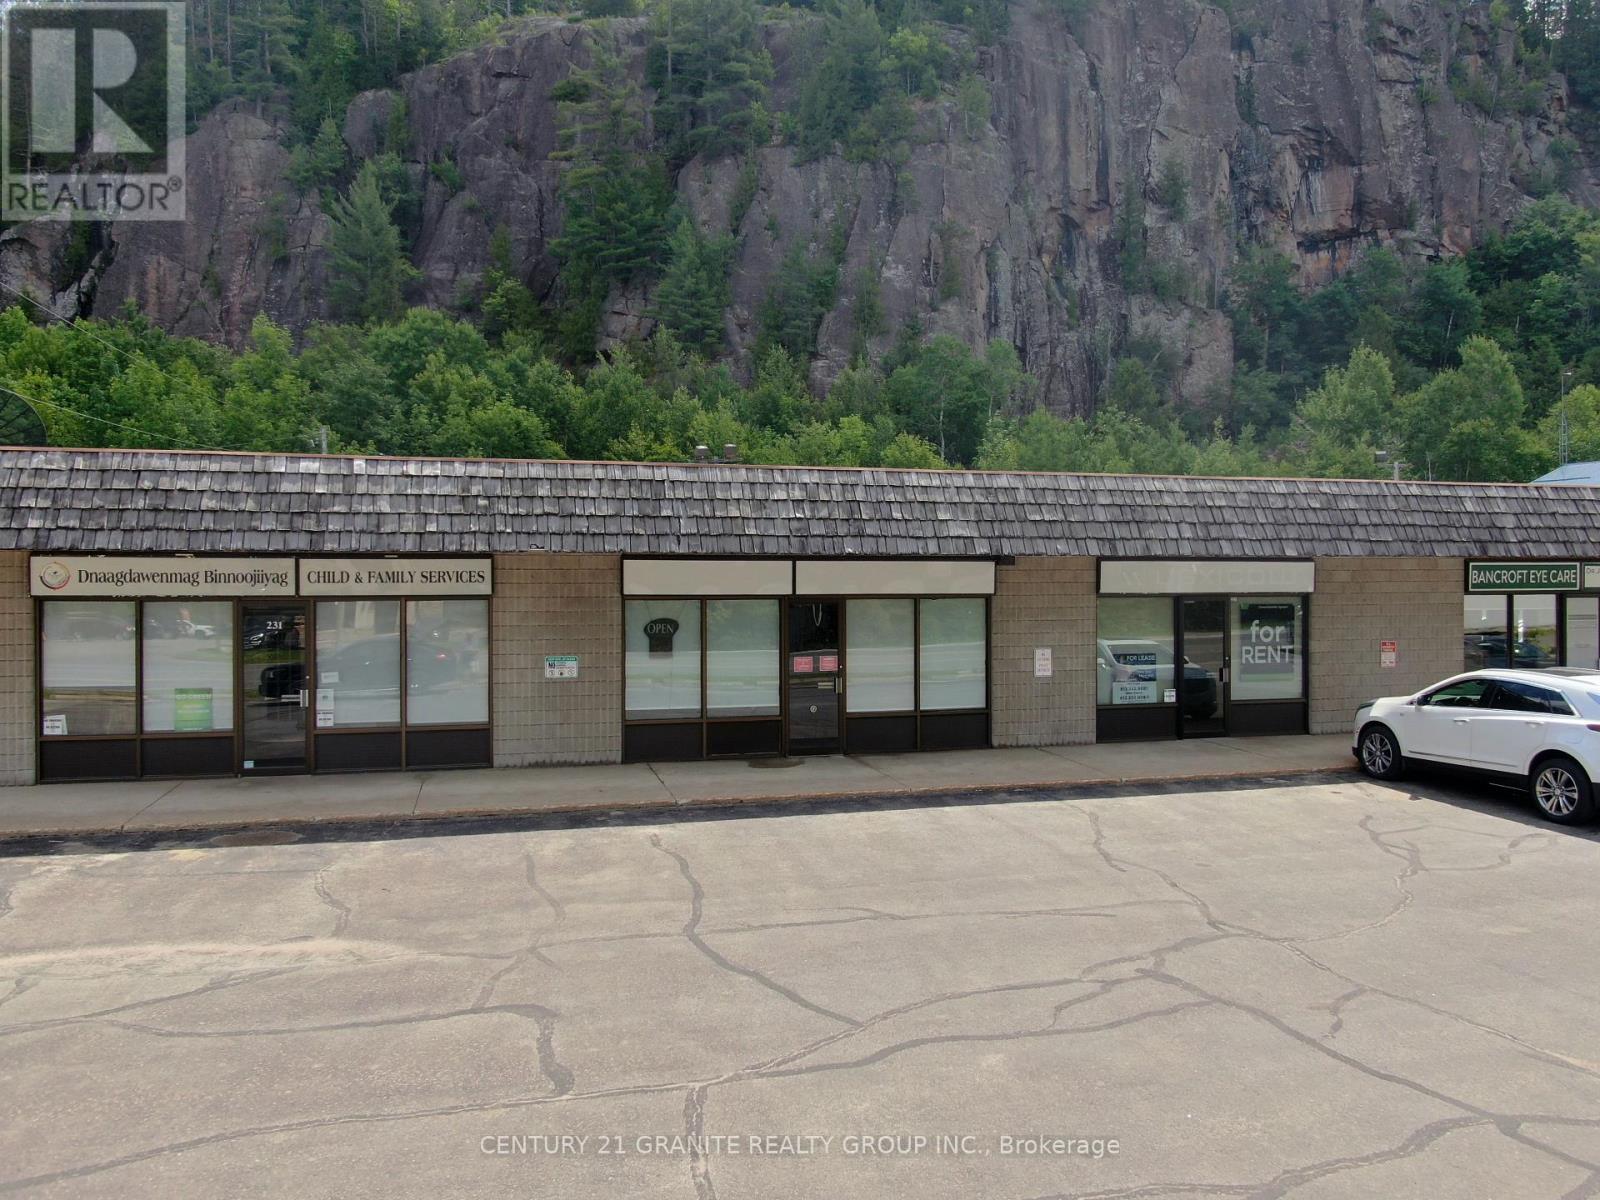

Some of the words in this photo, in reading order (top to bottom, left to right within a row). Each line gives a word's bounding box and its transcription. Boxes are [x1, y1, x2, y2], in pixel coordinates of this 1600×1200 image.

[77, 569, 200, 587] Dnaagdawenmag
[204, 569, 289, 587] Binnoojiiyag
[307, 570, 350, 584] CHILD
[354, 571, 363, 584] &
[367, 570, 416, 584] FAMILY
[420, 570, 486, 584] SERVICES
[1472, 570, 1528, 583] BANCROFT
[1529, 570, 1548, 583] EYE
[1549, 569, 1577, 583] CARE
[266, 621, 283, 630] 231
[647, 623, 674, 634] OPEN
[1250, 619, 1286, 643] for
[1241, 645, 1294, 664] RENT
